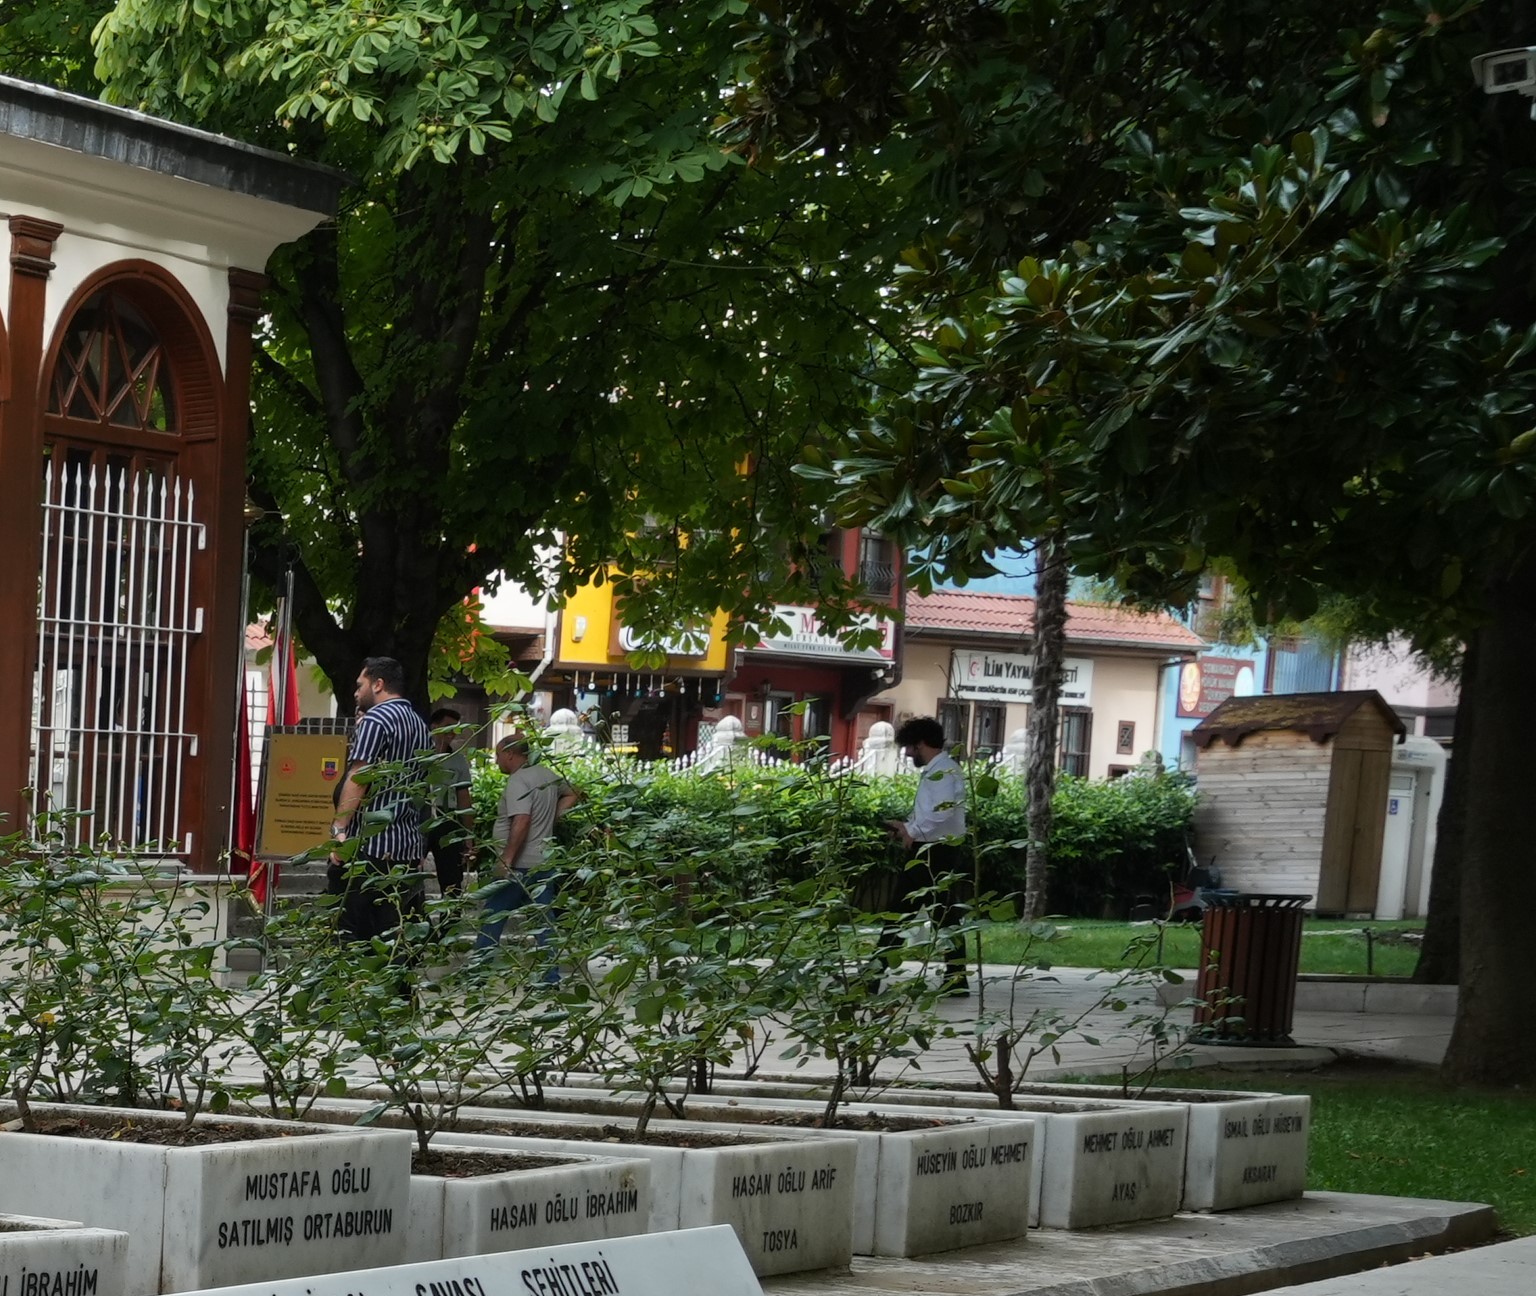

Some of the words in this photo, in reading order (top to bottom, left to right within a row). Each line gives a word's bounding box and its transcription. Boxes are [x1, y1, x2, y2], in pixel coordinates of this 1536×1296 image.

[984, 656, 1003, 677] İLİM
[1224, 1116, 1248, 1138] İSMAİL
[1252, 1114, 1271, 1136] OĞLU
[1273, 1112, 1302, 1133] HÜSEYİN
[1084, 1132, 1118, 1154] MEHMET
[1121, 1127, 1144, 1150] OĞLU
[1147, 1128, 1175, 1149] AHMET
[916, 1147, 957, 1176] HÜSEYİN
[962, 1143, 986, 1171] OĞLU
[991, 1142, 1028, 1167] MEHMET
[245, 1170, 321, 1201] MUSTAFA
[332, 1162, 371, 1195] OĞLU
[732, 1173, 771, 1199] HASAN
[778, 1167, 805, 1194] OĞLU
[811, 1163, 837, 1191] ARİF
[1242, 1165, 1277, 1184] AKSARAY
[490, 1202, 537, 1232] HASAN
[545, 1193, 579, 1224] OĞLU
[949, 1202, 984, 1225] BOZKIR
[218, 1216, 294, 1249] SATILMIŞ
[303, 1208, 393, 1241] ORTABURUN
[763, 1228, 798, 1253] TOSYA
